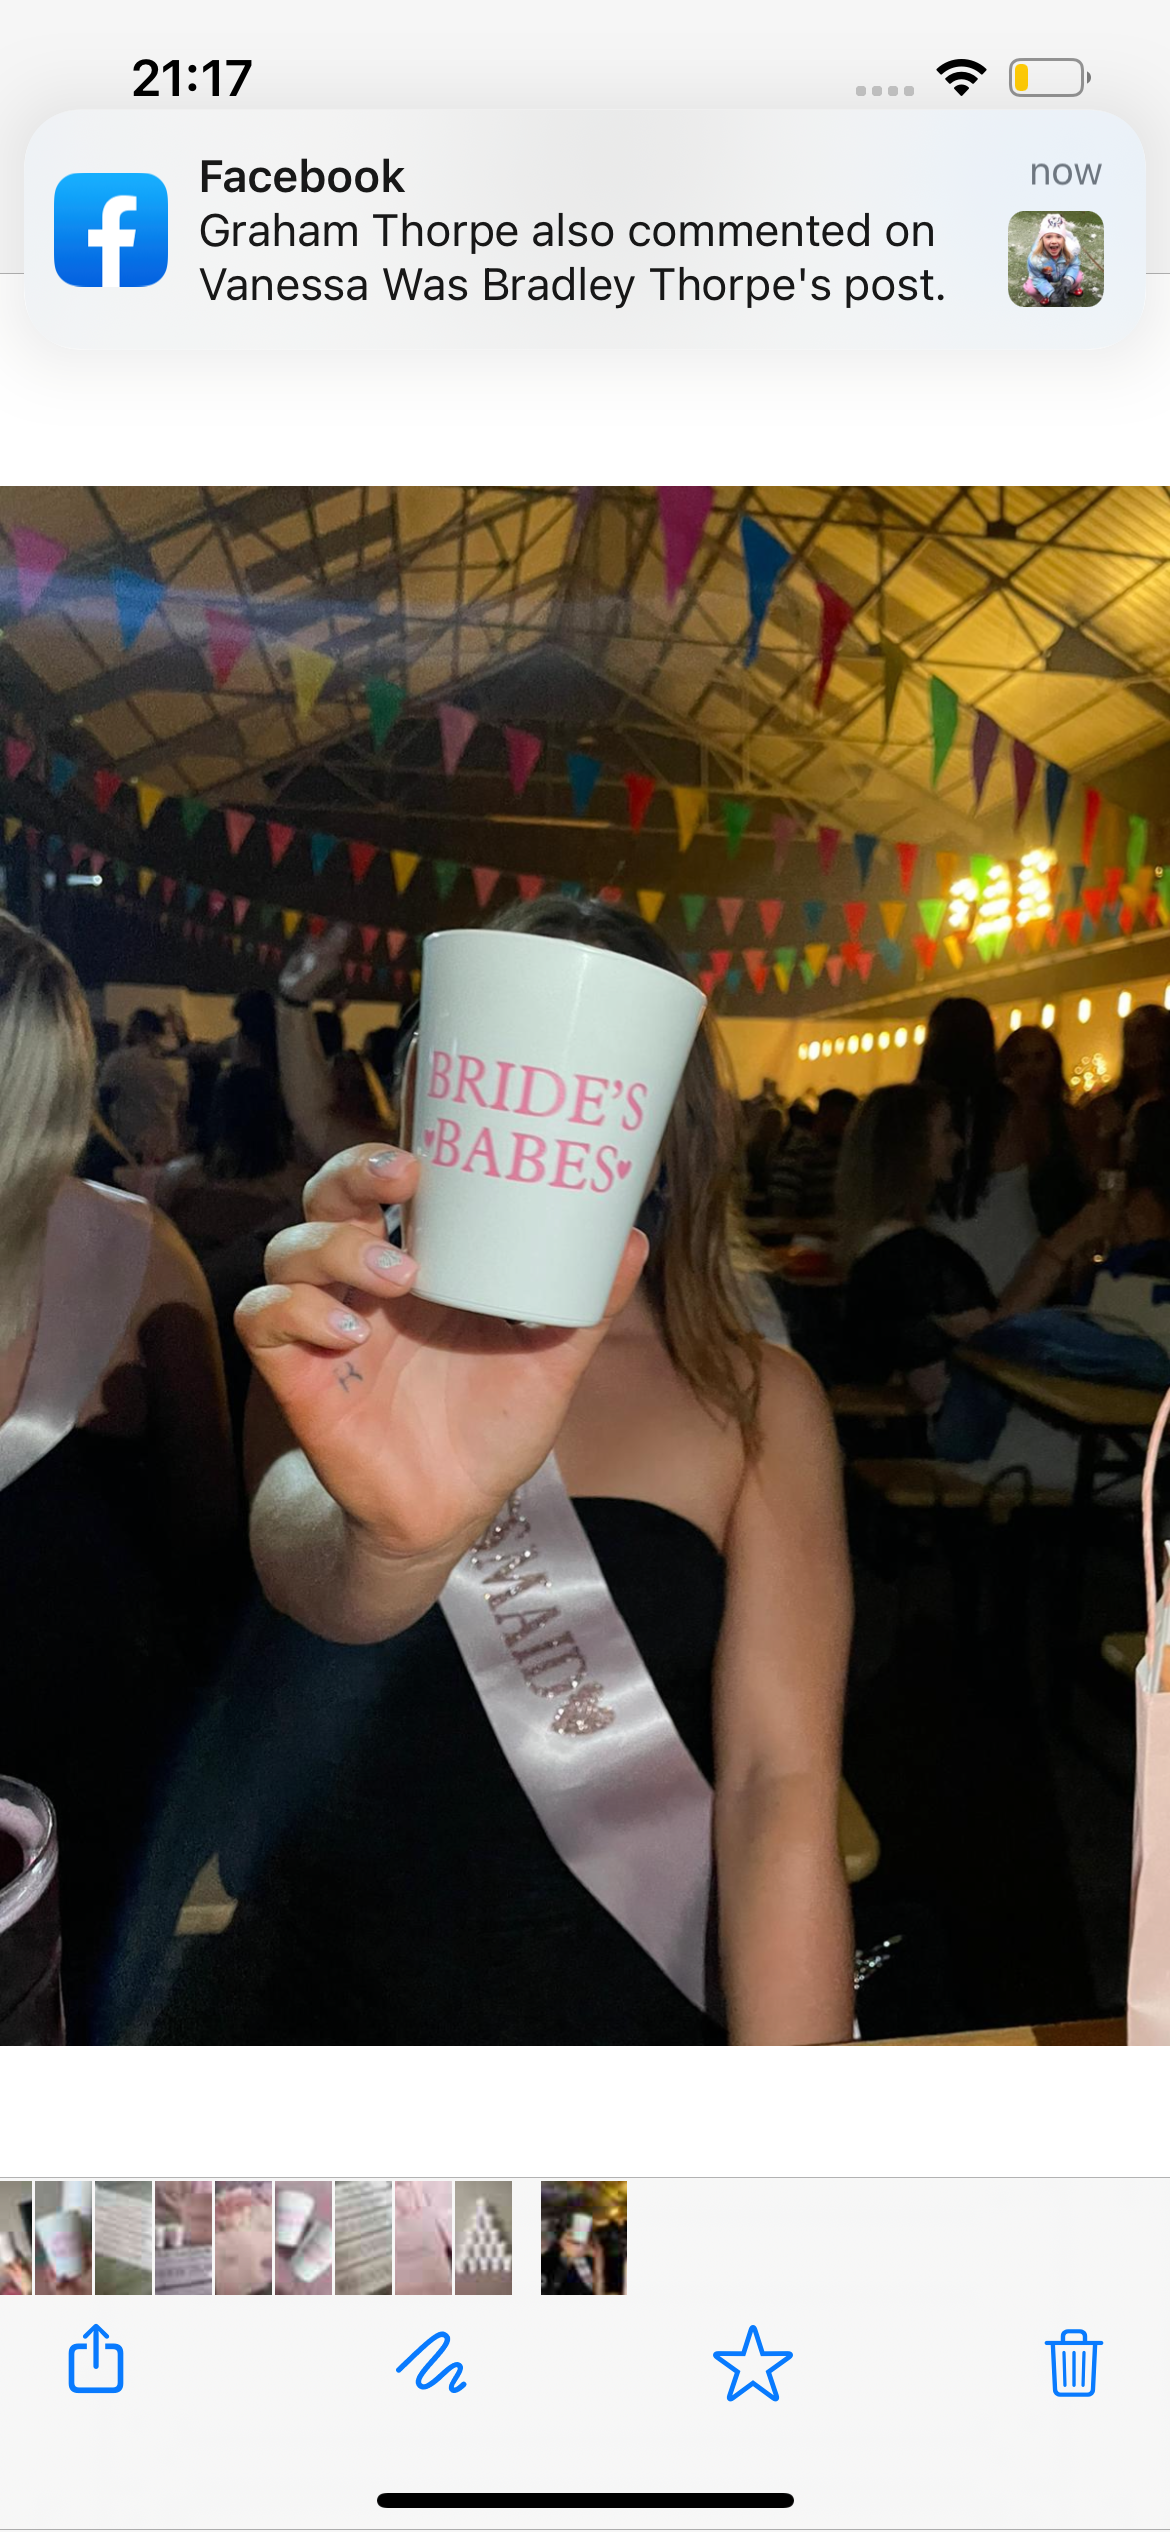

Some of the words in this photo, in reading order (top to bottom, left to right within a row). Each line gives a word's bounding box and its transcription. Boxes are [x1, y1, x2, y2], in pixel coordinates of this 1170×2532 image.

[133, 59, 252, 97] 21:17
[201, 159, 406, 194] Facebook
[1030, 162, 1103, 186] now
[200, 213, 358, 248] Graham
[373, 213, 518, 255] Thorpe
[533, 213, 614, 247] also
[629, 213, 870, 247] commented
[886, 222, 934, 247] on
[200, 268, 367, 301] Vanessa
[383, 268, 468, 301] Was
[485, 267, 636, 309] Bradley
[650, 267, 831, 309] Thorpe's
[846, 270, 945, 309] post.
[427, 1050, 648, 1132] BRIDE'S
[432, 1118, 618, 1193] BABES
